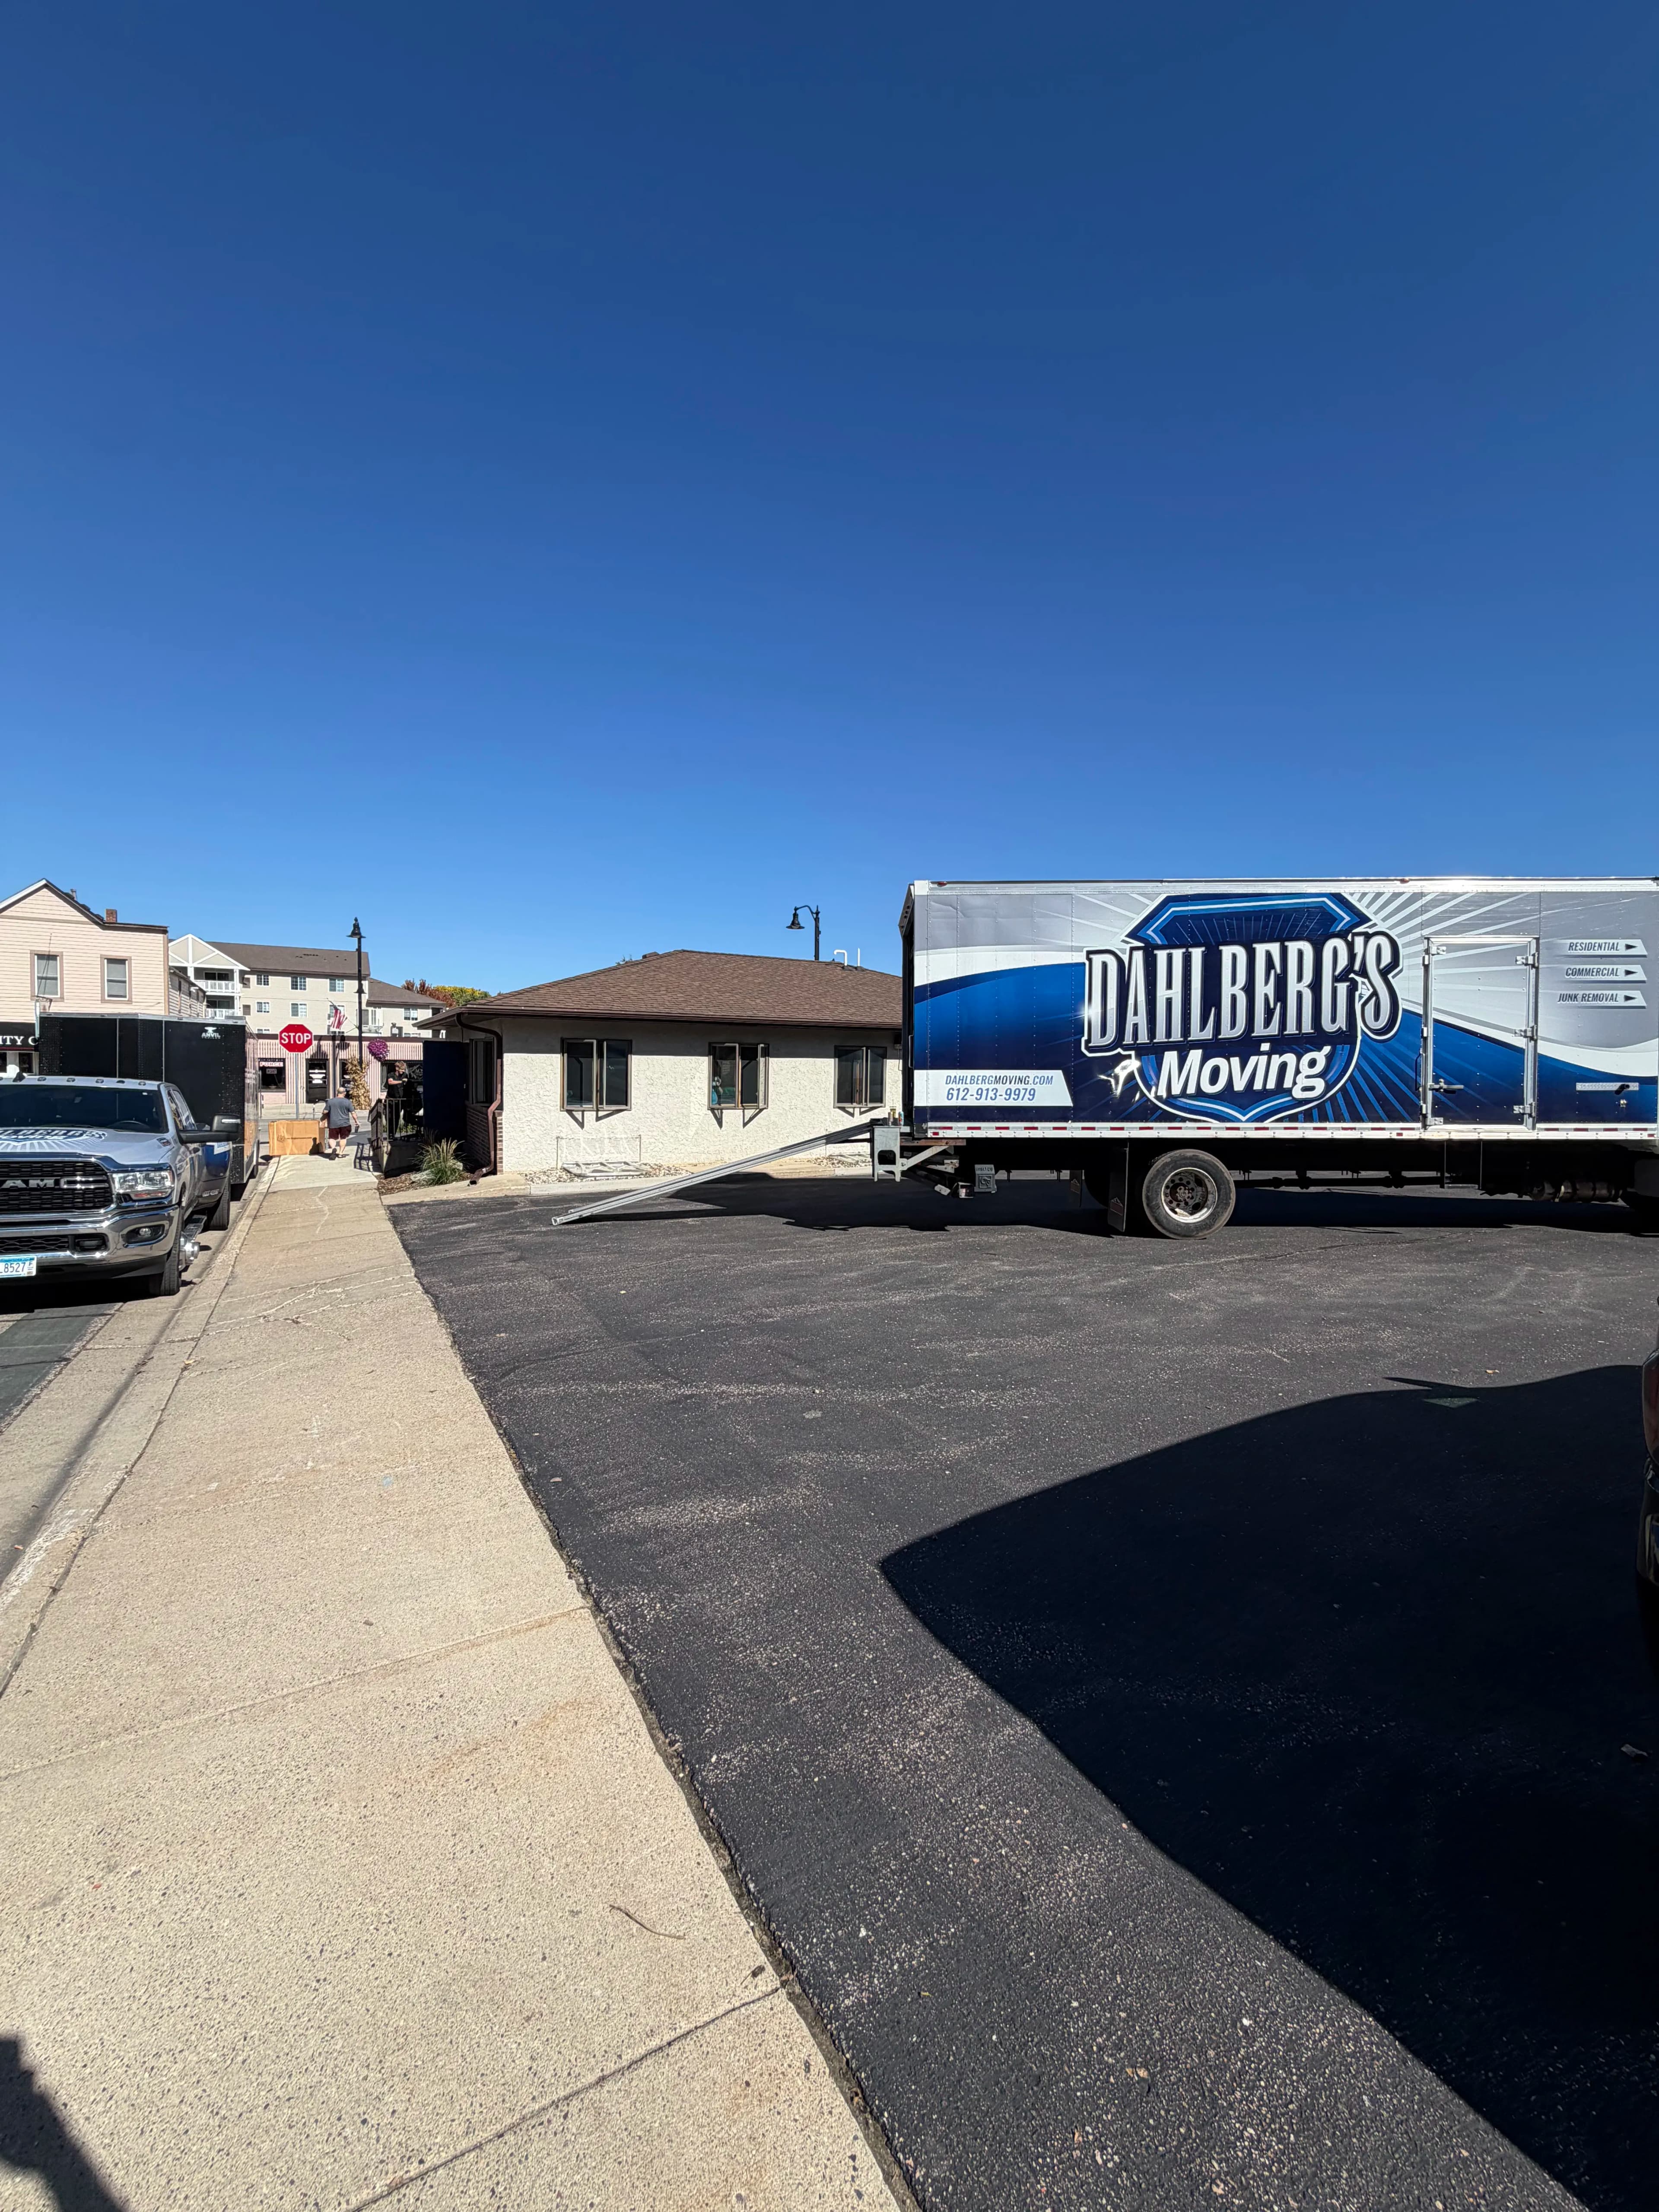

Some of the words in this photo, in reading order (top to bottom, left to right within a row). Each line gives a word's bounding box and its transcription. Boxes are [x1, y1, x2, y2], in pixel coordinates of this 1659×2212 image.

[1568, 942, 1620, 951] RESIDENTIAL
[1565, 967, 1620, 977] COMMERCIAL
[1088, 934, 1395, 1047] DAHLBERG'S
[1557, 993, 1579, 1002] JUNK
[1581, 993, 1619, 1002] REMOVAL
[281, 1032, 311, 1044] STOP
[1157, 1042, 1332, 1099] Moving
[945, 1075, 1053, 1085] DAHLBERGMOVING.COM
[946, 1087, 1036, 1101] 612-913-9979
